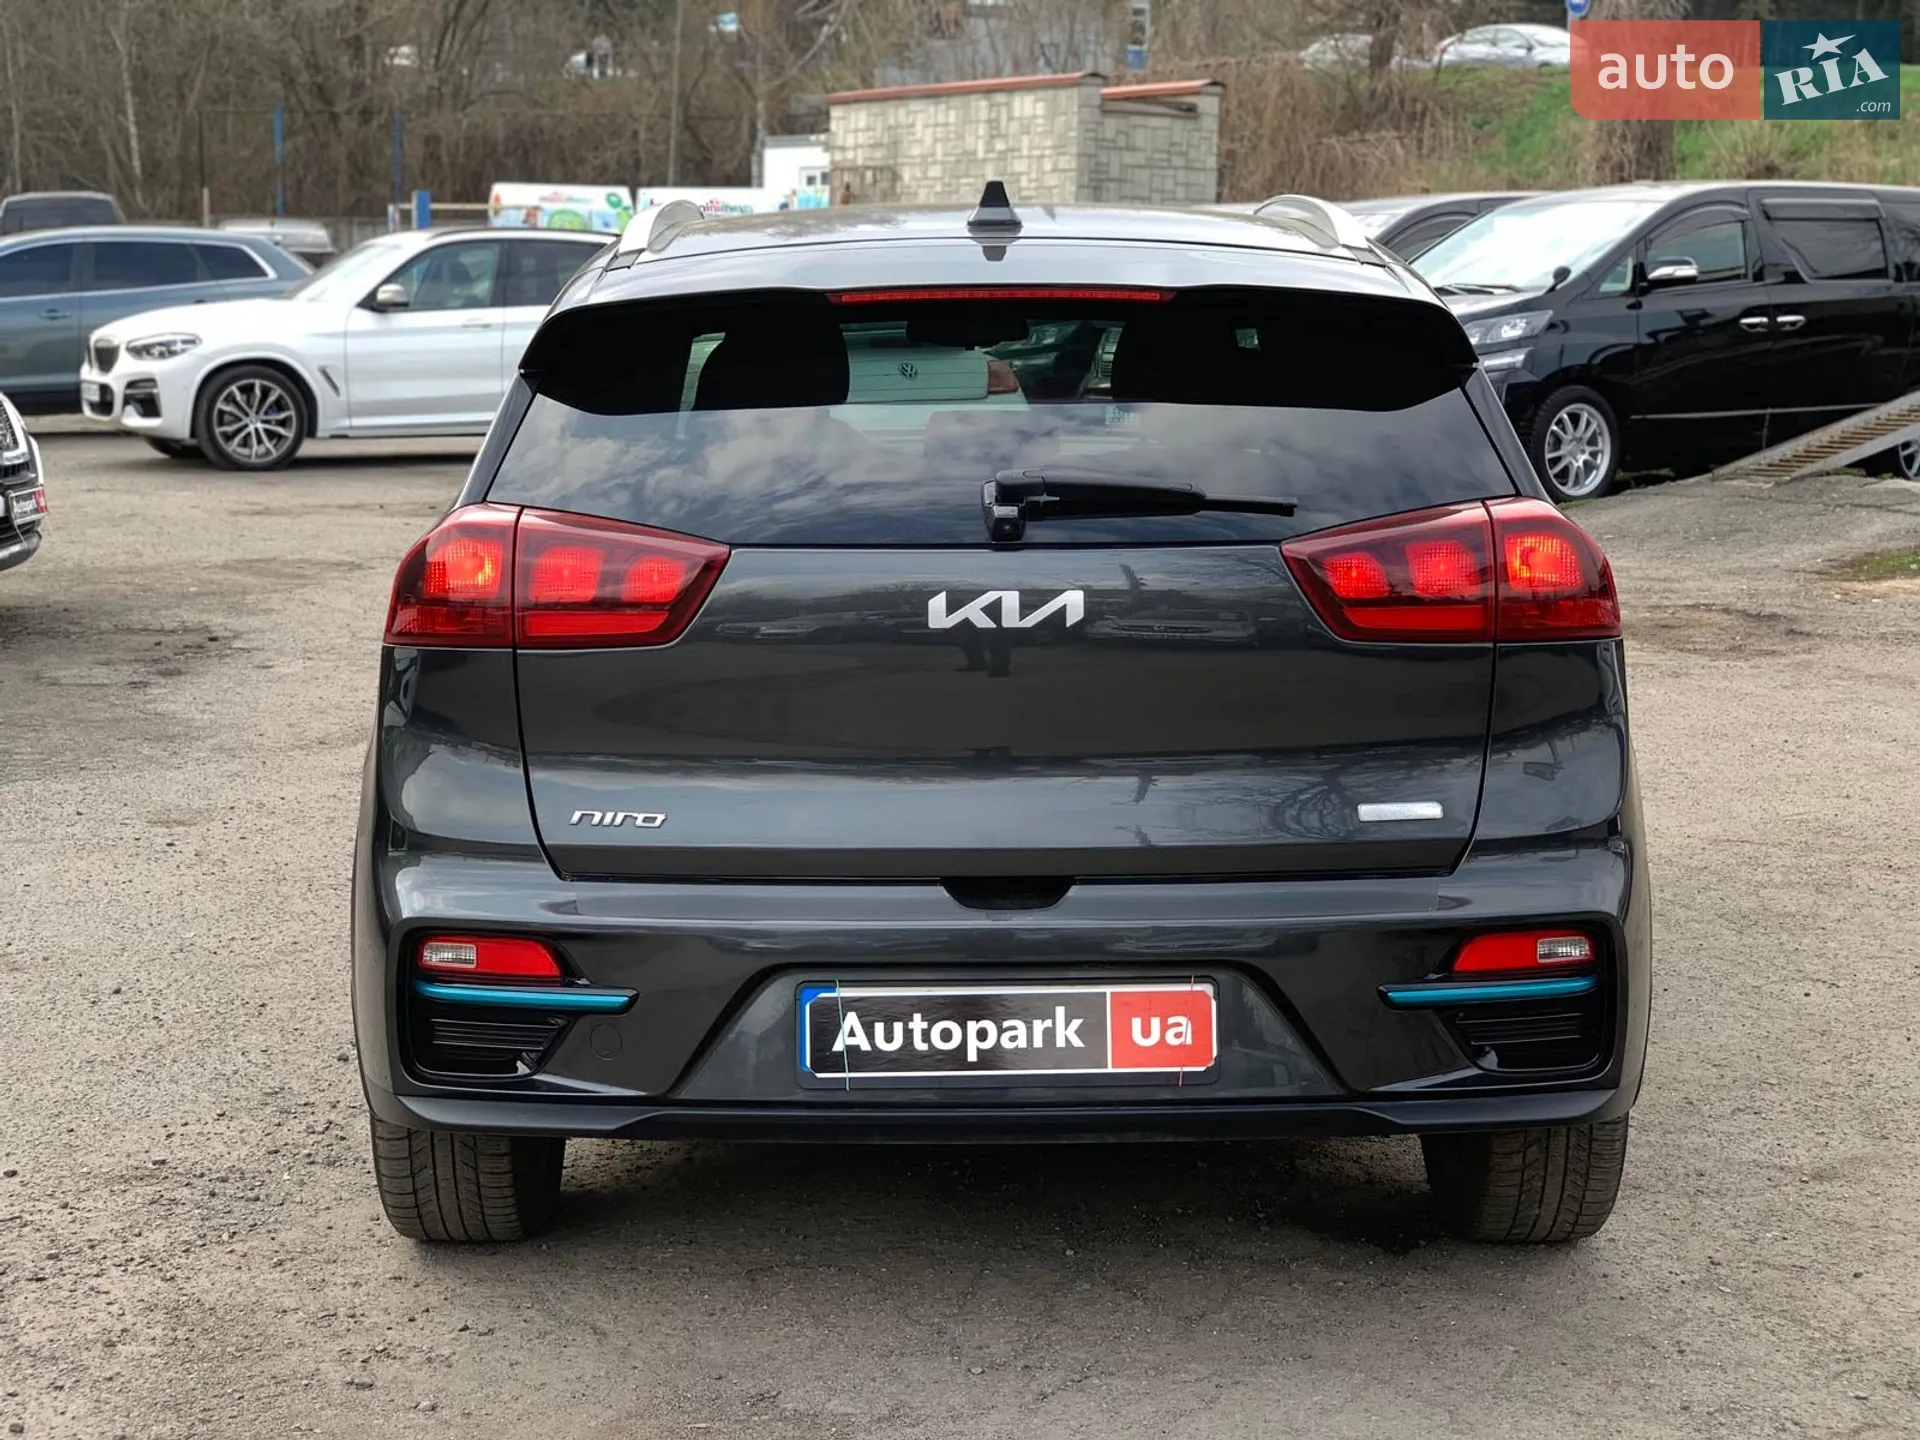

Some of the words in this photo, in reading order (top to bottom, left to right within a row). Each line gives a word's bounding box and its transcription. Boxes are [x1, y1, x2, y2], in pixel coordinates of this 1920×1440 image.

[928, 590, 1084, 629] KIA
[569, 809, 668, 828] niro
[831, 1005, 1086, 1062] Autopark
[1130, 1013, 1193, 1048] ua
